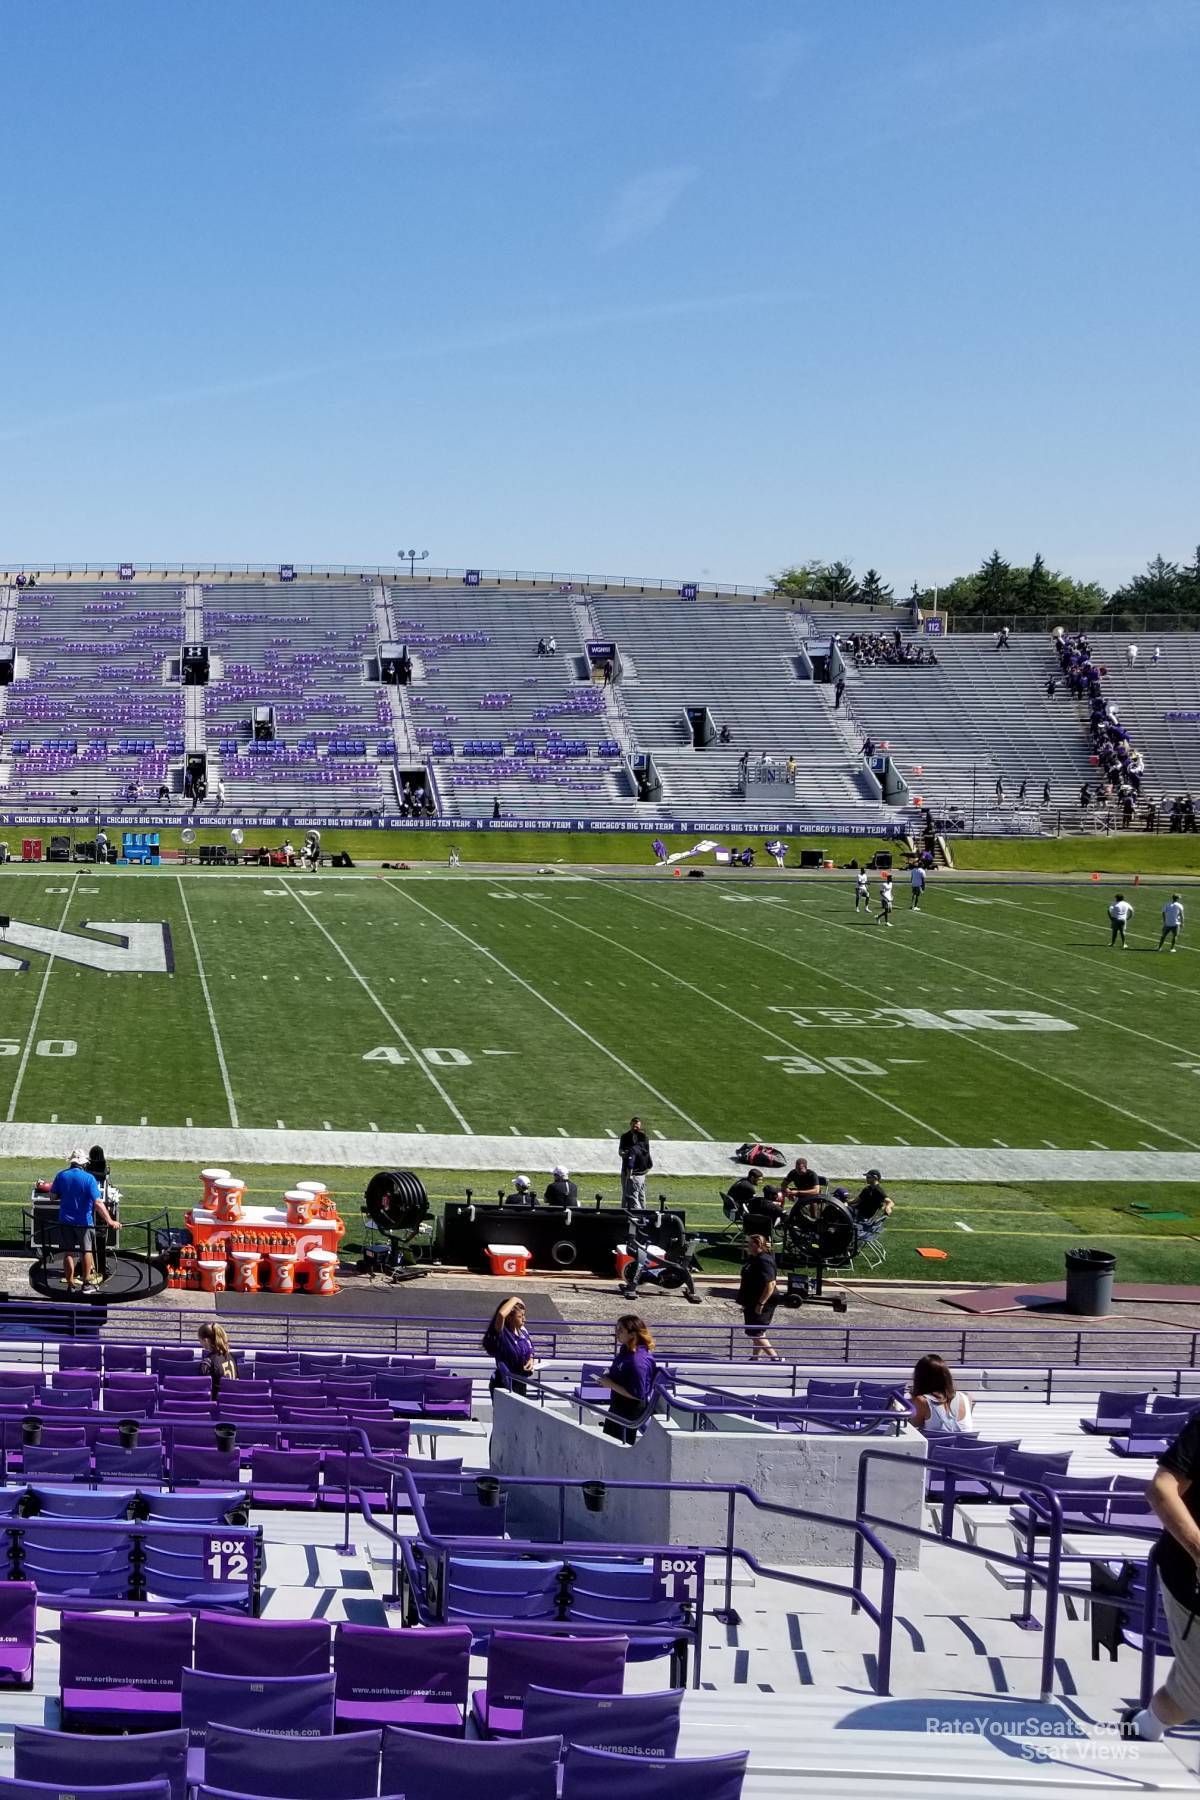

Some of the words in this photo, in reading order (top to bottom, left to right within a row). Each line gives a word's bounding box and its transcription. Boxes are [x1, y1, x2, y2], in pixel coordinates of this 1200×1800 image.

[929, 623, 940, 632] 112
[362, 1046, 473, 1065] 40
[761, 1055, 888, 1075] 30
[226, 1193, 236, 1204] G
[297, 1206, 305, 1216] G
[241, 1265, 251, 1277] G
[278, 1265, 288, 1277] G
[504, 1259, 517, 1273] G
[319, 1268, 330, 1280] G
[222, 1360, 235, 1380] 51
[211, 1541, 245, 1554] BOX
[208, 1555, 248, 1580] 12
[661, 1560, 697, 1573] BOX
[661, 1574, 698, 1599] 11
[75, 1676, 174, 1685] www.northwesternseats.com
[352, 1686, 452, 1697] www.northwesternseats.com
